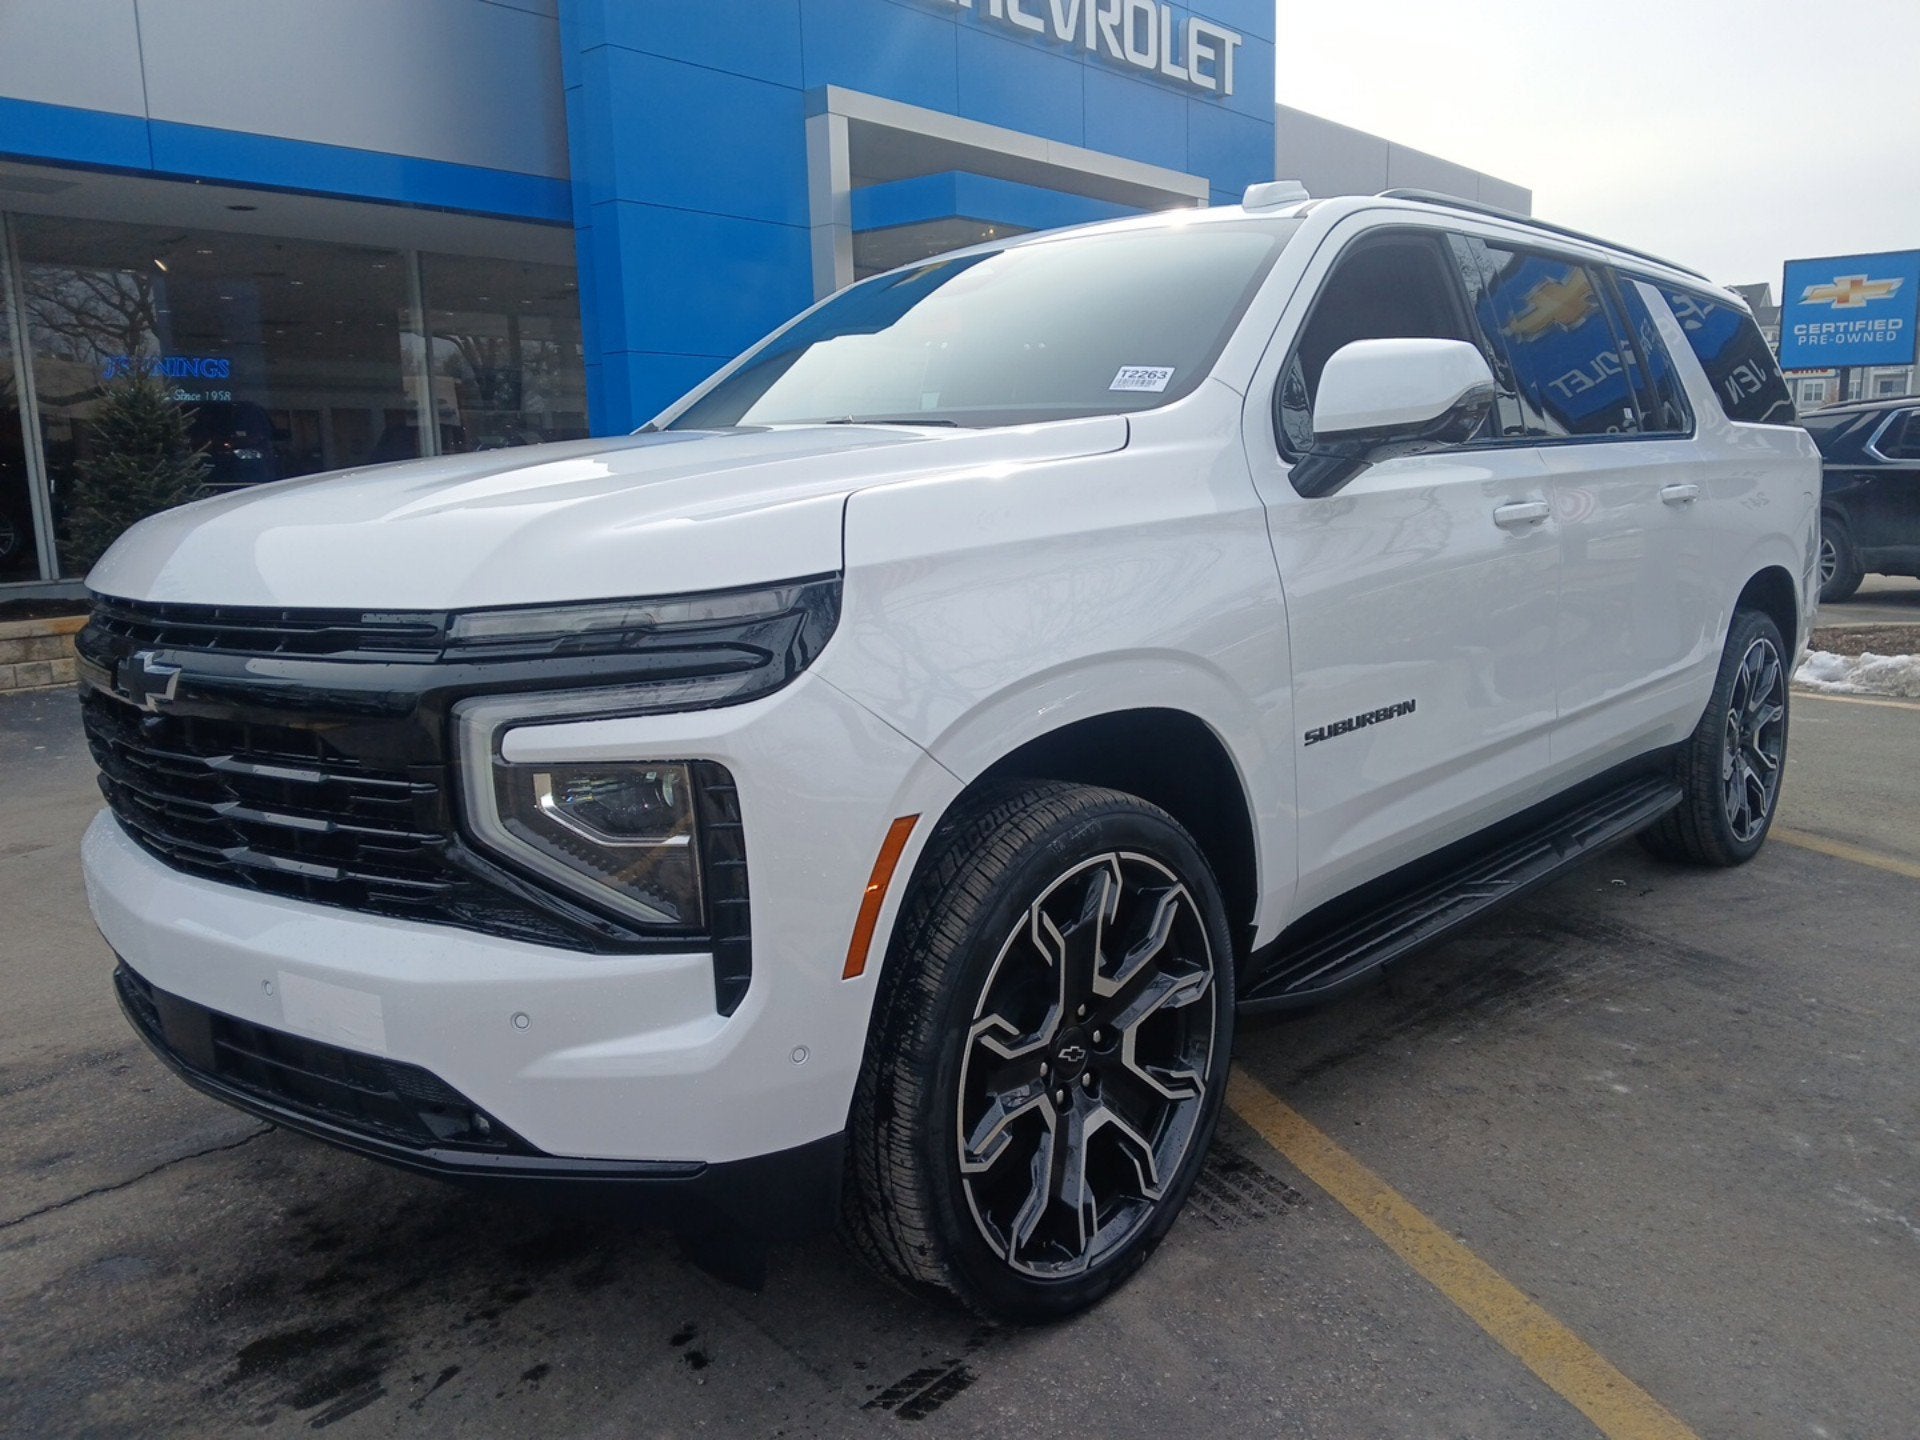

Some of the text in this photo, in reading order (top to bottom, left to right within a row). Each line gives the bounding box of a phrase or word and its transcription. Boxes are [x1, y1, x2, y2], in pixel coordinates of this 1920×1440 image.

[947, 0, 1242, 96] VROLET
[1794, 318, 1904, 336] CERTIFIED
[1798, 331, 1897, 346] PRE-OWNED
[103, 355, 231, 379] JENINGS
[1121, 369, 1169, 381] T2263
[204, 390, 232, 401] 1958
[1304, 698, 1417, 747] SUBURBAN
